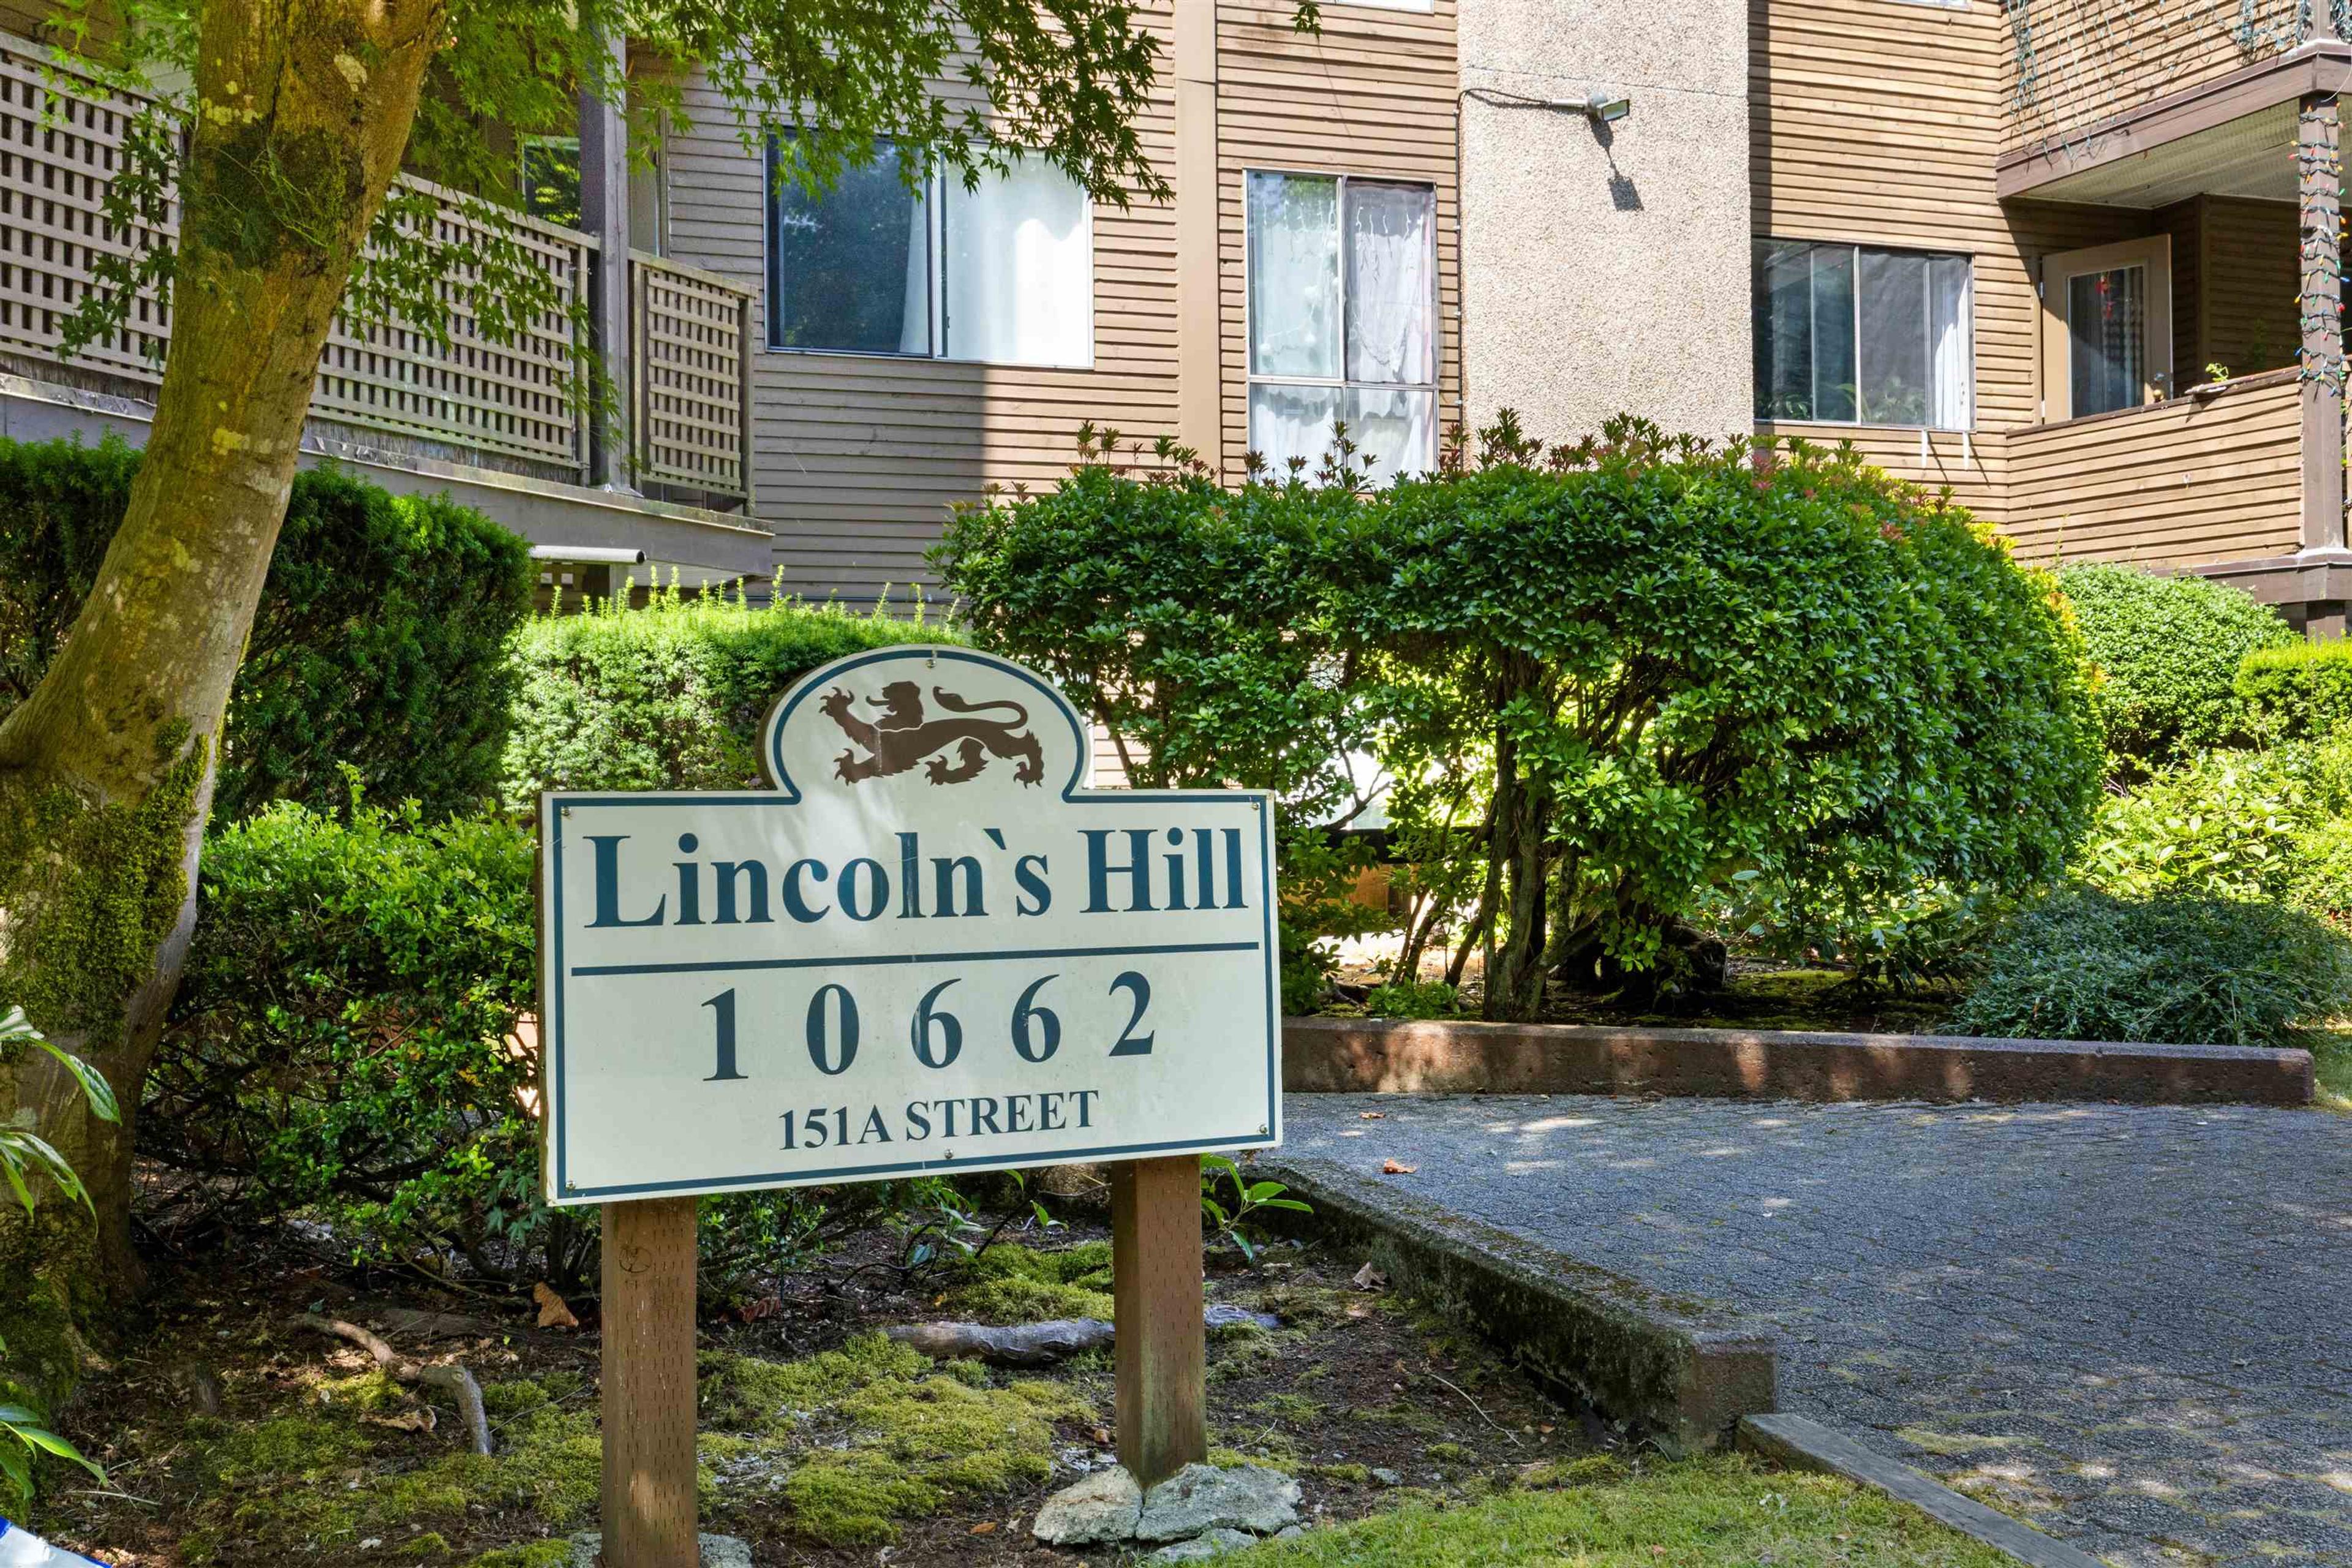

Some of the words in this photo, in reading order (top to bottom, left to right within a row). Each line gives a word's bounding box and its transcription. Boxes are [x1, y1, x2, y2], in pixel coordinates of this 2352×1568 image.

[1076, 826, 1250, 914] Hill
[778, 1104, 894, 1151] 151A
[905, 1089, 1099, 1142] STREET
